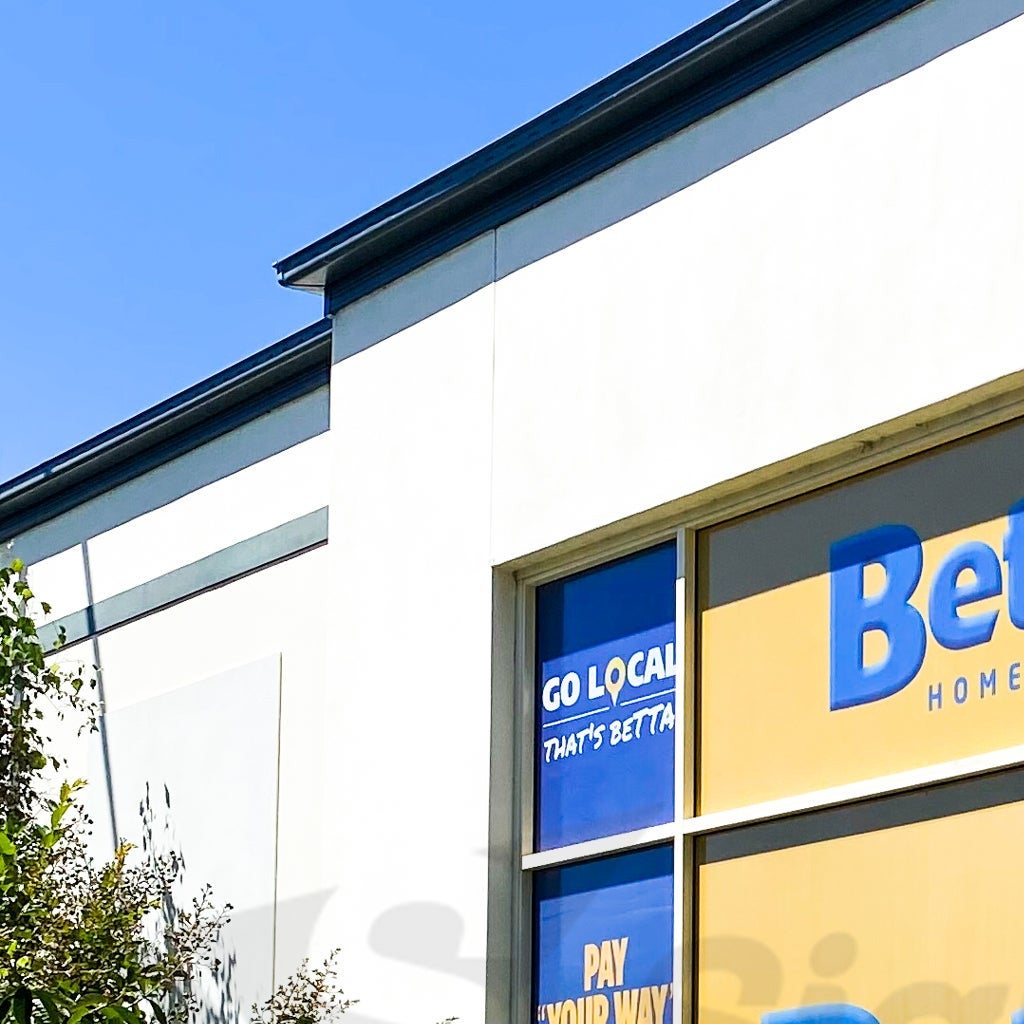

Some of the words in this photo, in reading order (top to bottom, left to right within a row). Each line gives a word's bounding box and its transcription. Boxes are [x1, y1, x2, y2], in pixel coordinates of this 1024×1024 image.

[542, 672, 581, 712] GO
[588, 642, 677, 706] LOCAL
[928, 663, 1021, 711] HOME
[544, 722, 604, 763] THAT'S
[584, 937, 629, 991] PAY
